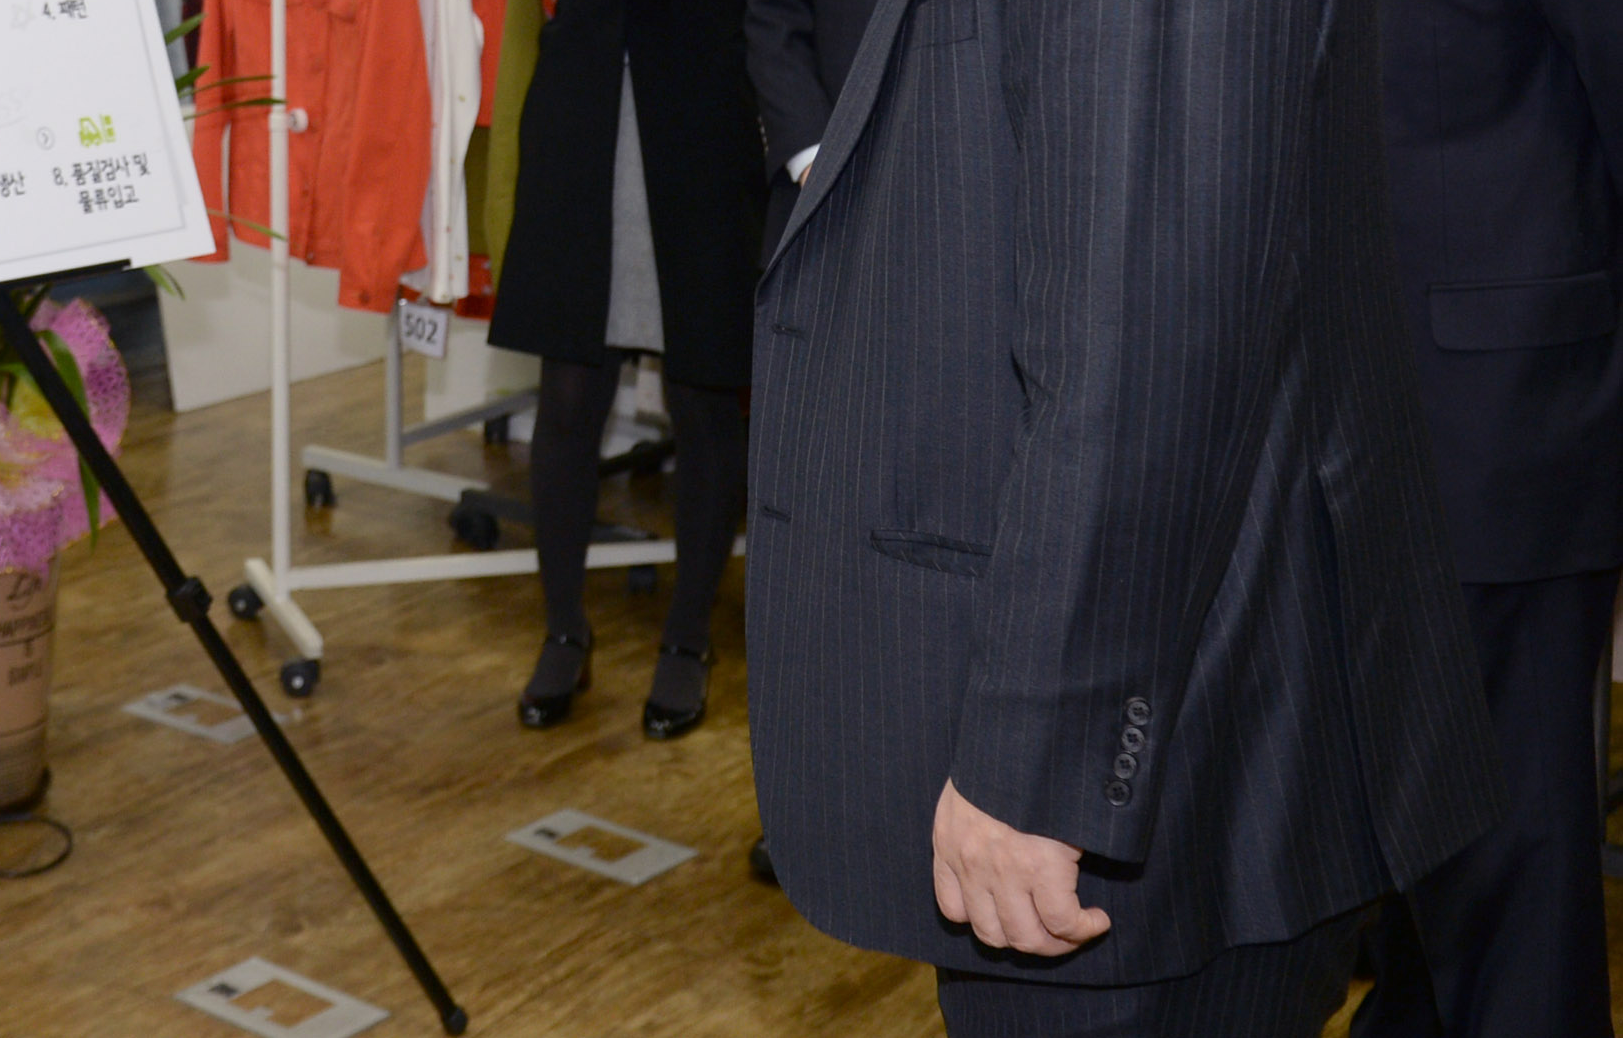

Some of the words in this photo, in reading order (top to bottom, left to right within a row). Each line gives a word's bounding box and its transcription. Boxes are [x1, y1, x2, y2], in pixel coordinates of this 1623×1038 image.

[52, 167, 68, 187] 8.
[71, 155, 130, 186] 품질검사
[132, 152, 150, 177] 및
[78, 184, 140, 214] 물류입고
[405, 313, 438, 345] 502
